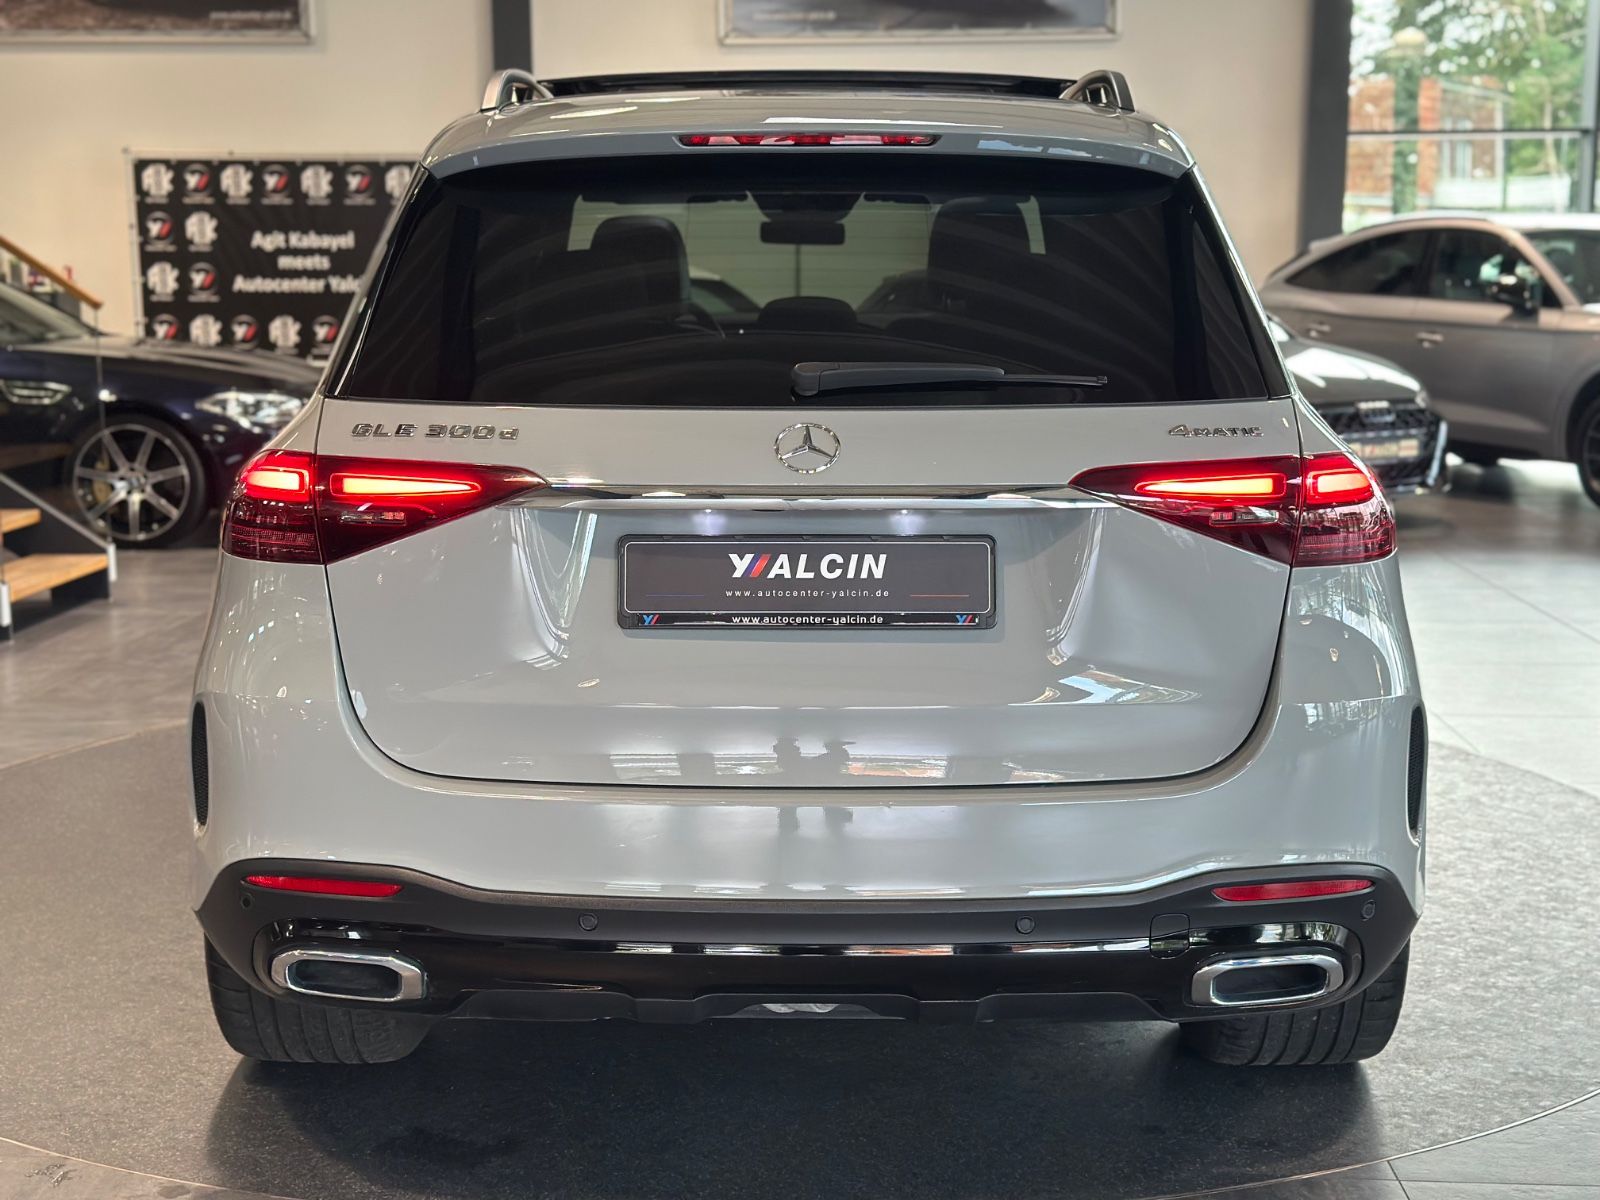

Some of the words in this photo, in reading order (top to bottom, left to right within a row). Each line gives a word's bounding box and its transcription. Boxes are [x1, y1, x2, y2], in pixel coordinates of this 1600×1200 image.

[250, 230, 287, 252] Agit
[288, 230, 355, 252] Kabayel
[277, 254, 331, 270] meets
[232, 274, 327, 293] Autocenter
[351, 423, 418, 438] GLE
[725, 589, 890, 599] www.autocenter-yalcin.de
[732, 614, 884, 625] www.autocenter-yalcin.de
